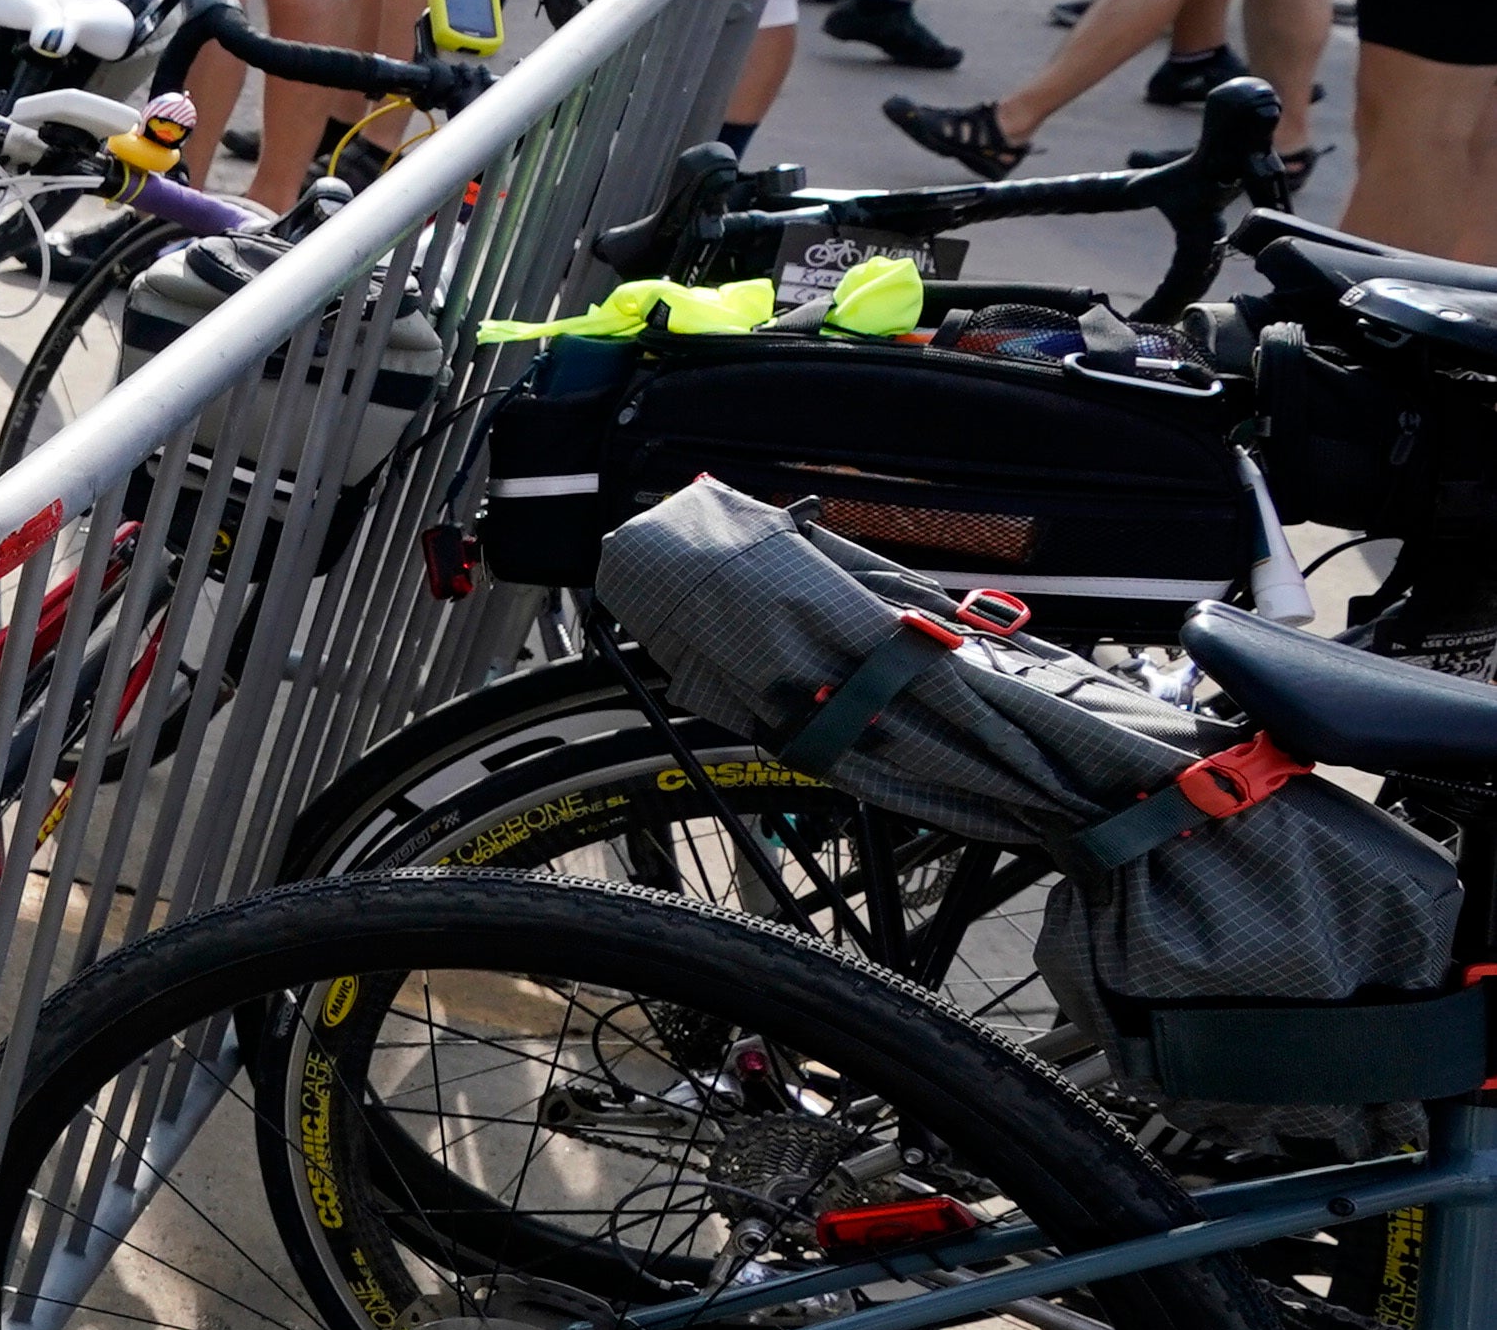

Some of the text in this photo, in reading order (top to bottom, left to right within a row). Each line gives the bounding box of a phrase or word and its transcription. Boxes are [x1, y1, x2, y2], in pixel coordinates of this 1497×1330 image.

[455, 790, 587, 864] CARBONE
[604, 795, 631, 809] SL
[330, 979, 354, 1019] MAVIC
[300, 1116, 343, 1230] COSMIC
